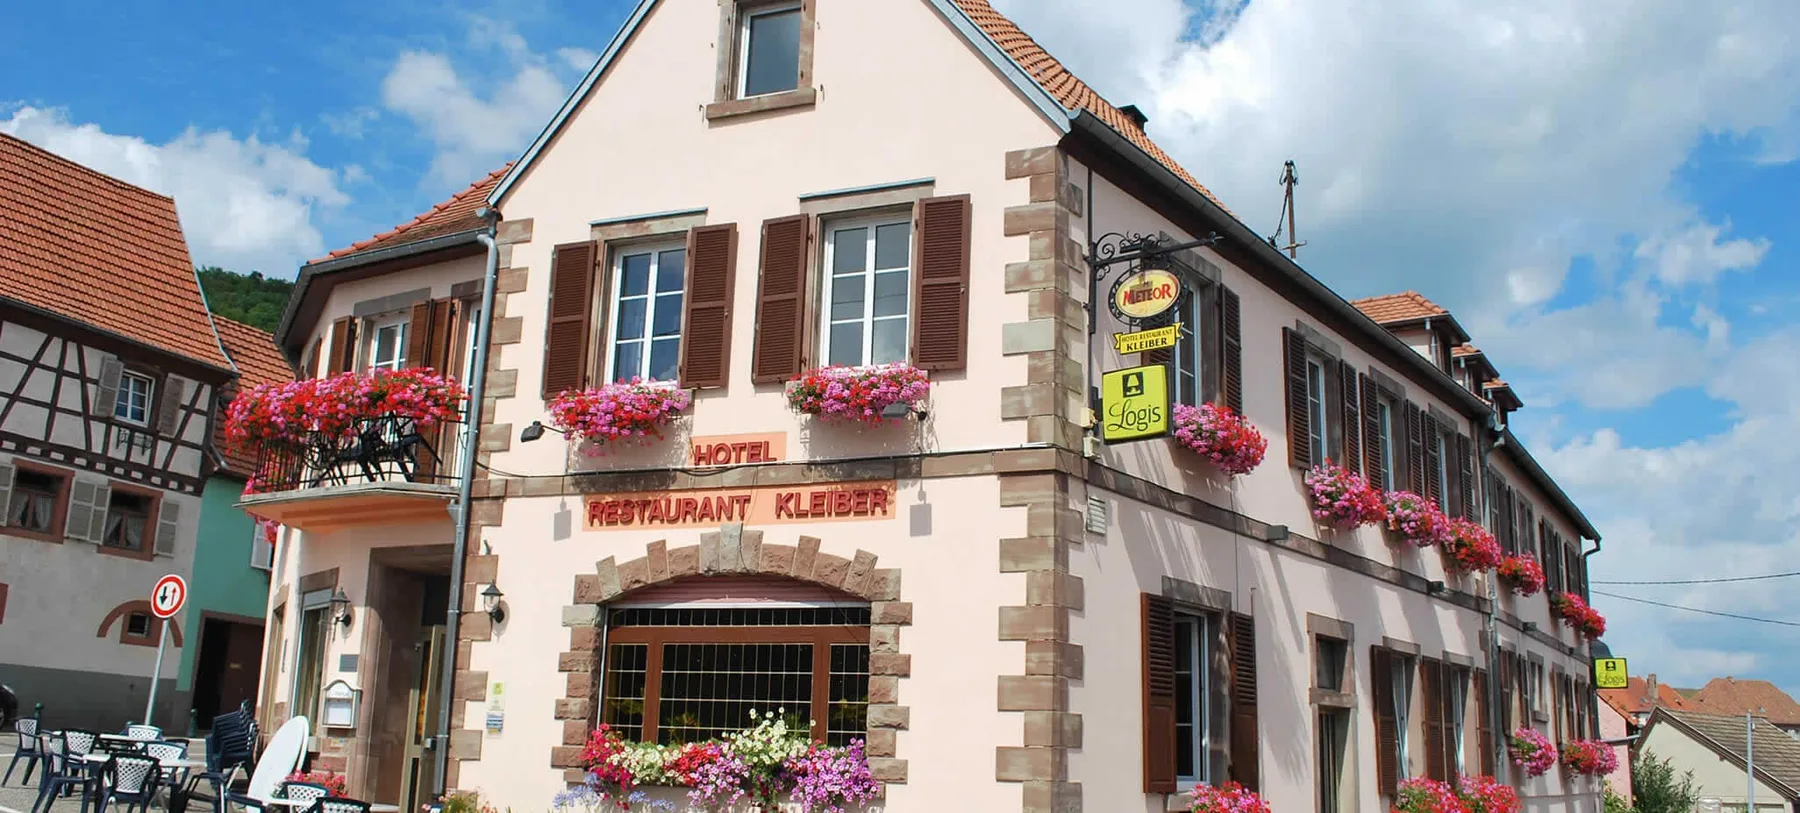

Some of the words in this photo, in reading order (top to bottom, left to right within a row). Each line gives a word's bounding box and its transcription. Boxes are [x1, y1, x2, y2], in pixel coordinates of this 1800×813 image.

[1123, 284, 1172, 306] METEOR
[1121, 334, 1138, 343] HOTEL
[1140, 328, 1173, 340] RESTAURANT
[1126, 338, 1167, 351] KLEIBER
[1107, 399, 1161, 431] Logis
[694, 441, 777, 466] HOTEL
[588, 495, 751, 526] RESTAURANT
[775, 489, 888, 519] KLEIBER
